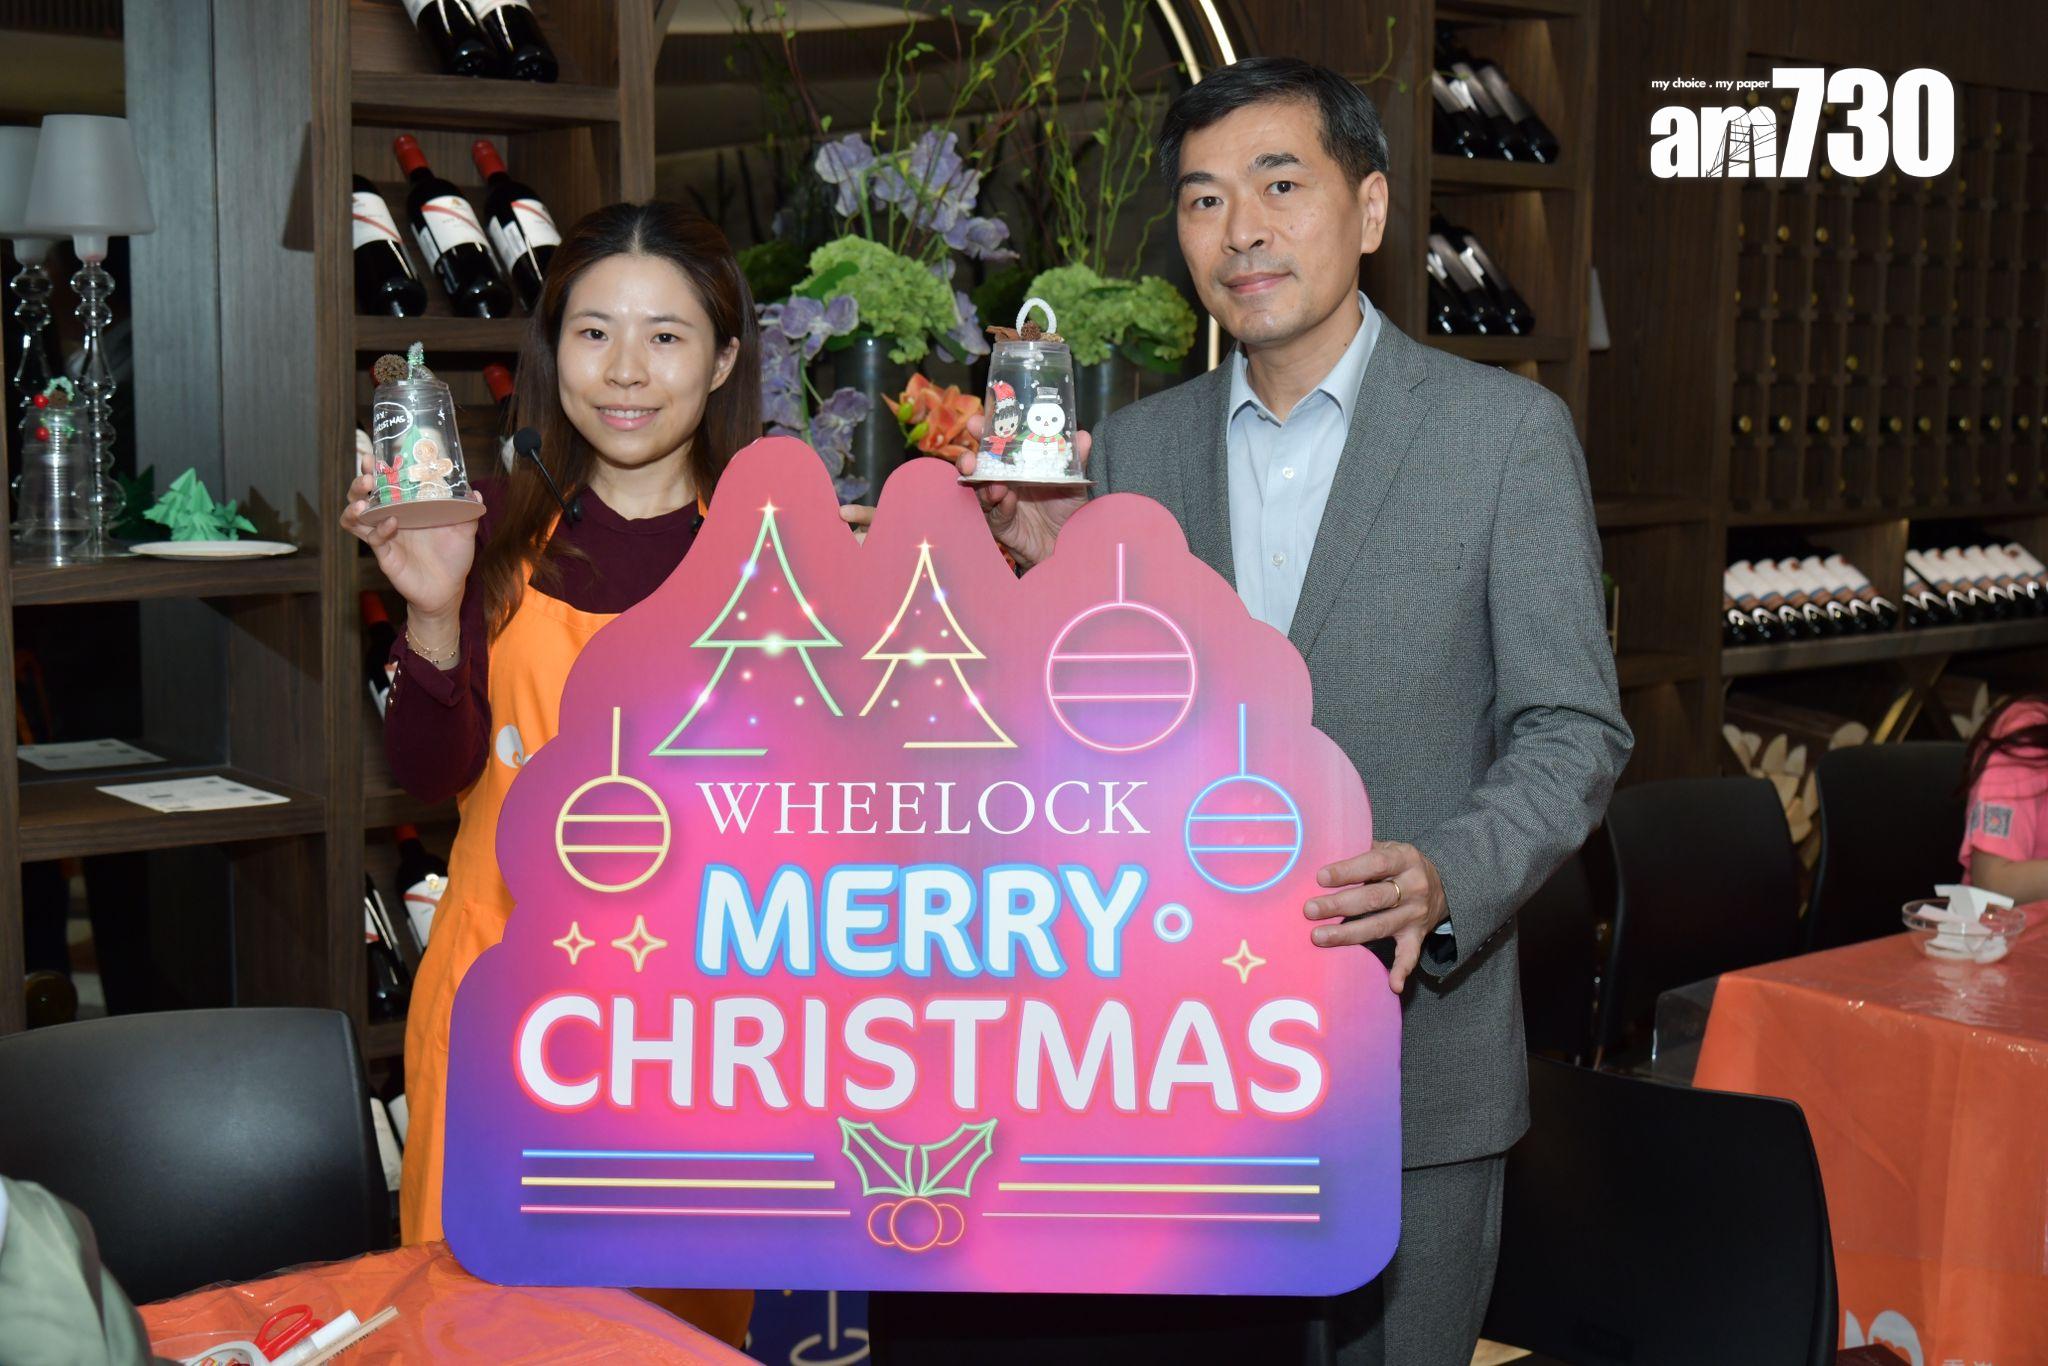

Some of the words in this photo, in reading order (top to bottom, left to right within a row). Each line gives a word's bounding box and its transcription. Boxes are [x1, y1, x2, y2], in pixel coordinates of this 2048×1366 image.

[695, 780, 1151, 835] WHEELOCK
[696, 863, 1148, 978] MERRY
[517, 994, 1328, 1115] CHRISTMAS
